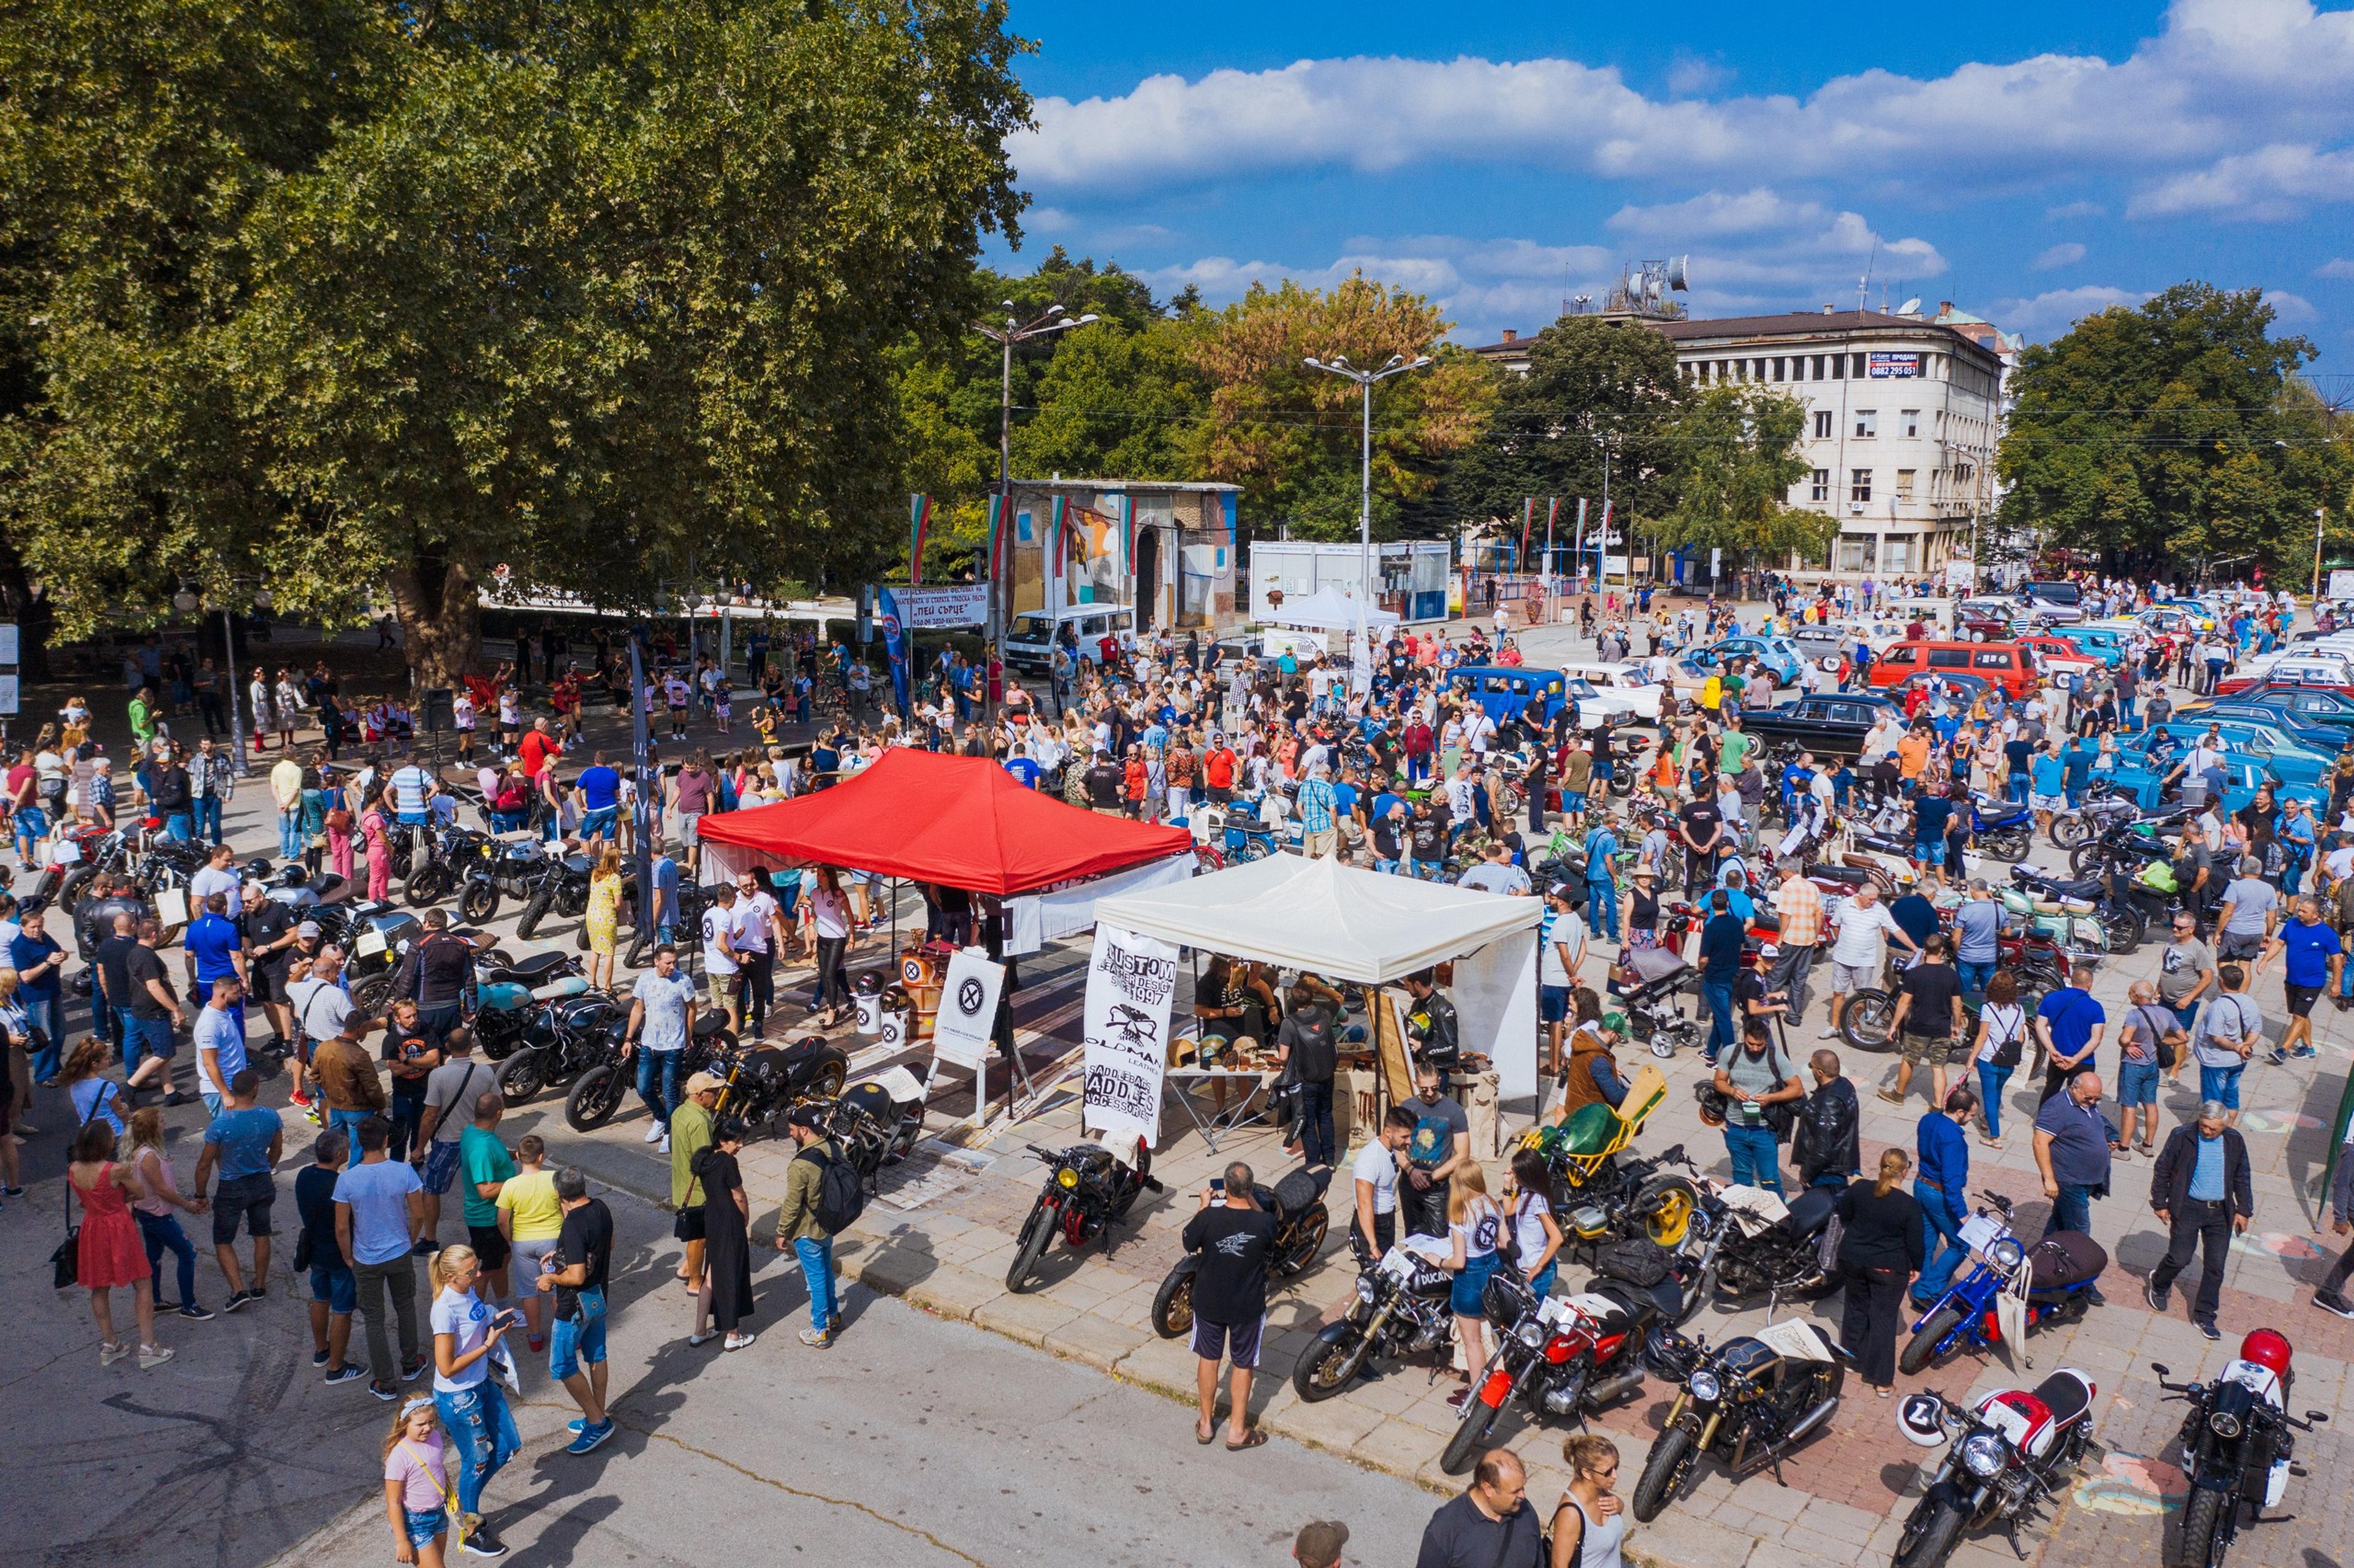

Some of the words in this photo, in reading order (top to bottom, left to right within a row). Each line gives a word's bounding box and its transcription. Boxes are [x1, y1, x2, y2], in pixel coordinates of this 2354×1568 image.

[1097, 958, 1135, 986] LEATHER
[1107, 943, 1176, 983] CUSTOM
[1130, 986, 1164, 1005] 1997
[1085, 1037, 1163, 1068] OLDMAN
[1089, 1065, 1151, 1092] SADDLEBAGS
